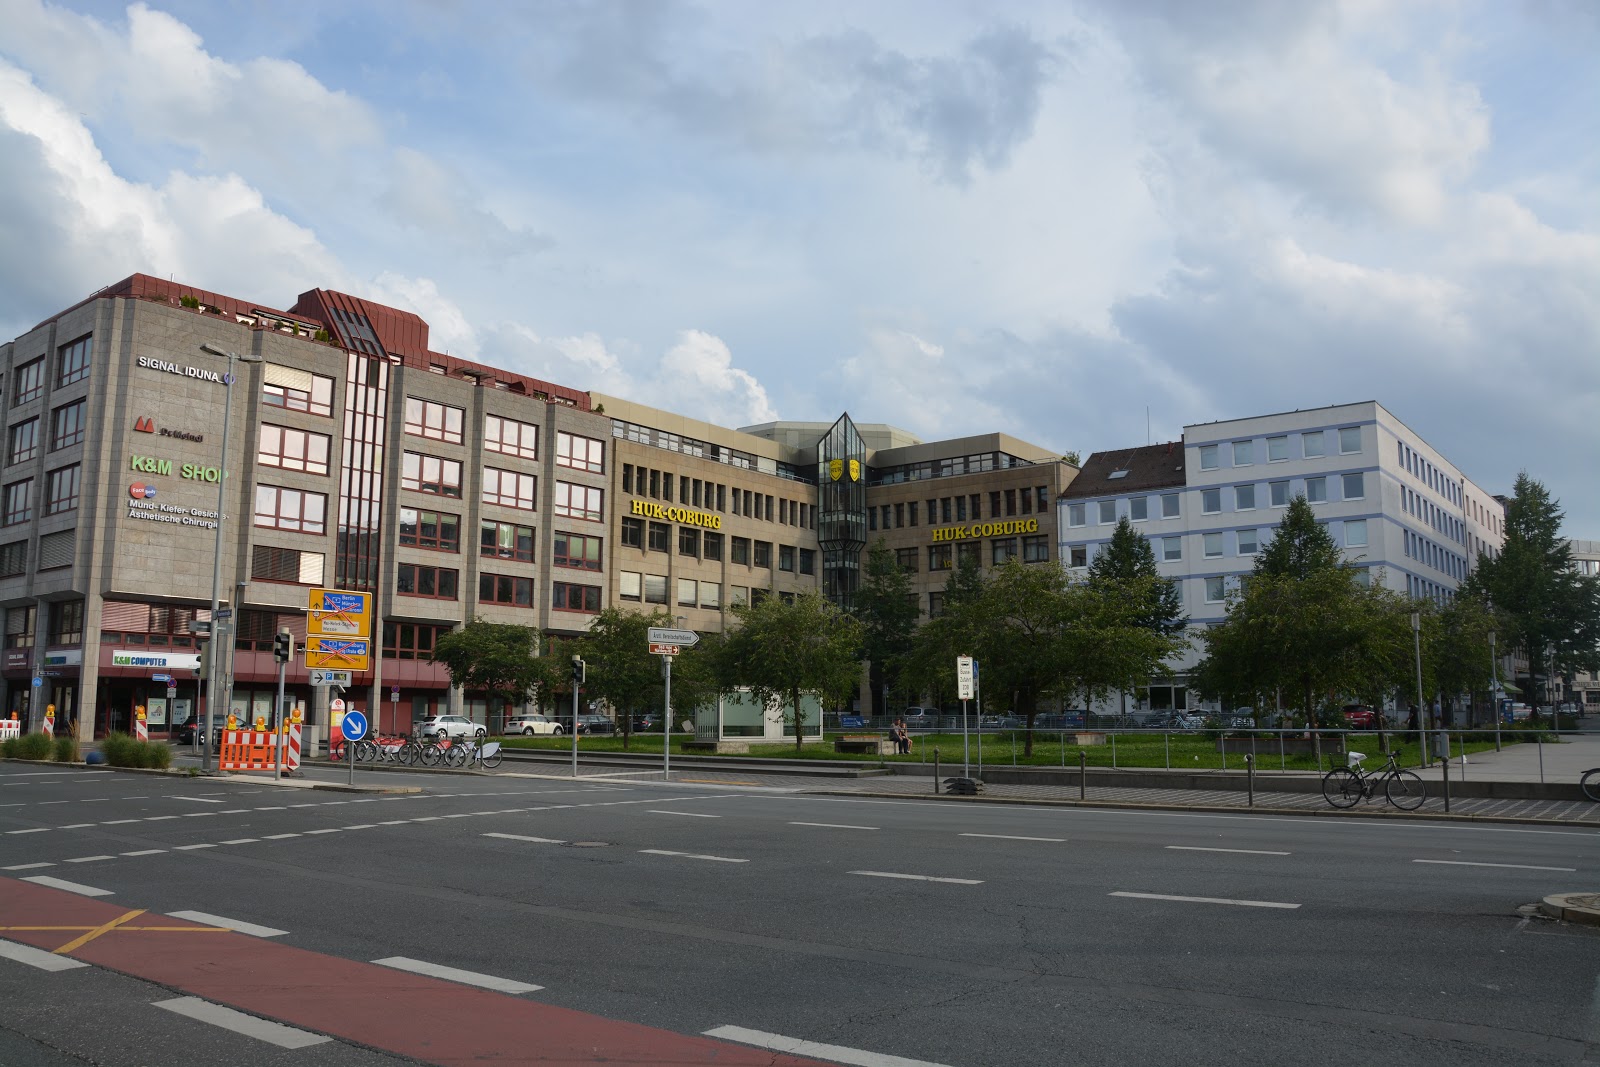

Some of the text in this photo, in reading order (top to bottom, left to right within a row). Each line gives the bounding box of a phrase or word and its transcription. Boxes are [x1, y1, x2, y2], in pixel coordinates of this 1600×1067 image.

[138, 356, 219, 382] SIGNAL IDUNA
[132, 455, 173, 476] K&M
[129, 499, 229, 520] Mund- Kiefer- Gesichs-
[129, 508, 181, 523] Ästhetische
[631, 499, 721, 529] HUK-COBURG
[932, 518, 1038, 542] HUK-COBURG
[114, 656, 166, 666] K&M COMPUTER
